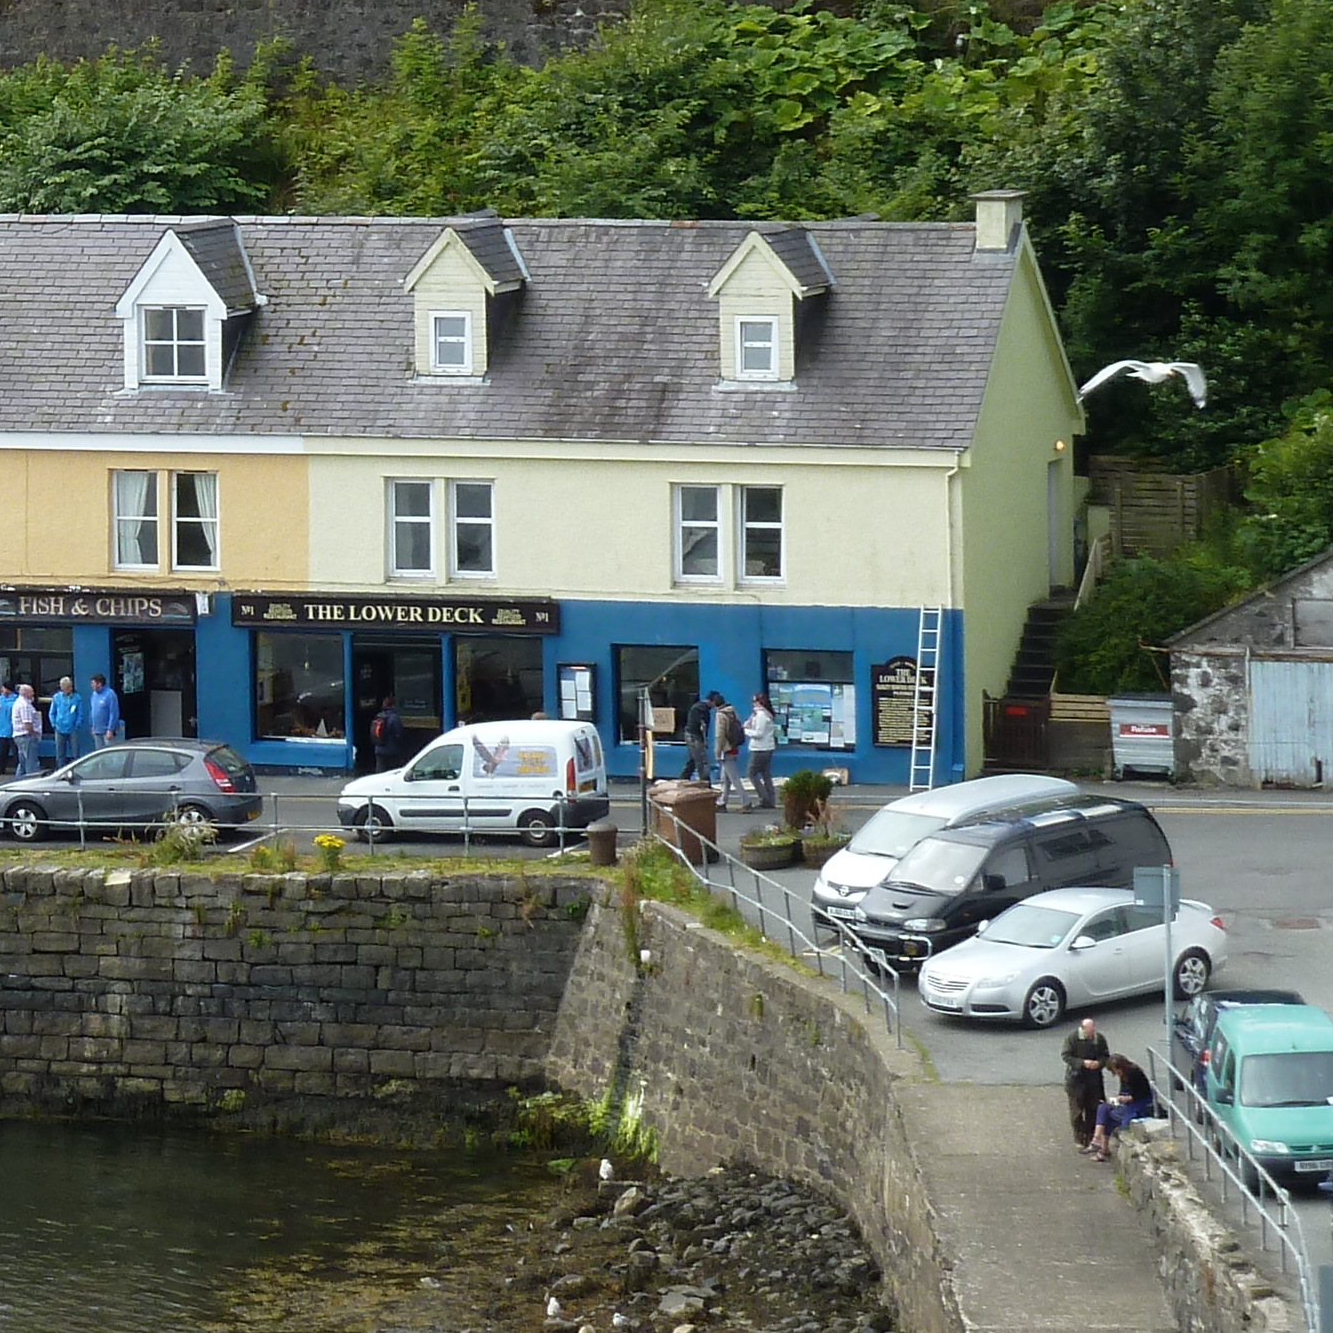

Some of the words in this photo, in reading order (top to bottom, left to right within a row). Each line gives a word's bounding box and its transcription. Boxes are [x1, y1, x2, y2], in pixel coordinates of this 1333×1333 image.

[18, 596, 65, 615] FISH
[70, 598, 89, 616] &
[95, 597, 163, 618] CHIPS
[304, 604, 345, 621] THE
[348, 605, 424, 622] LOWER
[427, 606, 485, 624] DECK
